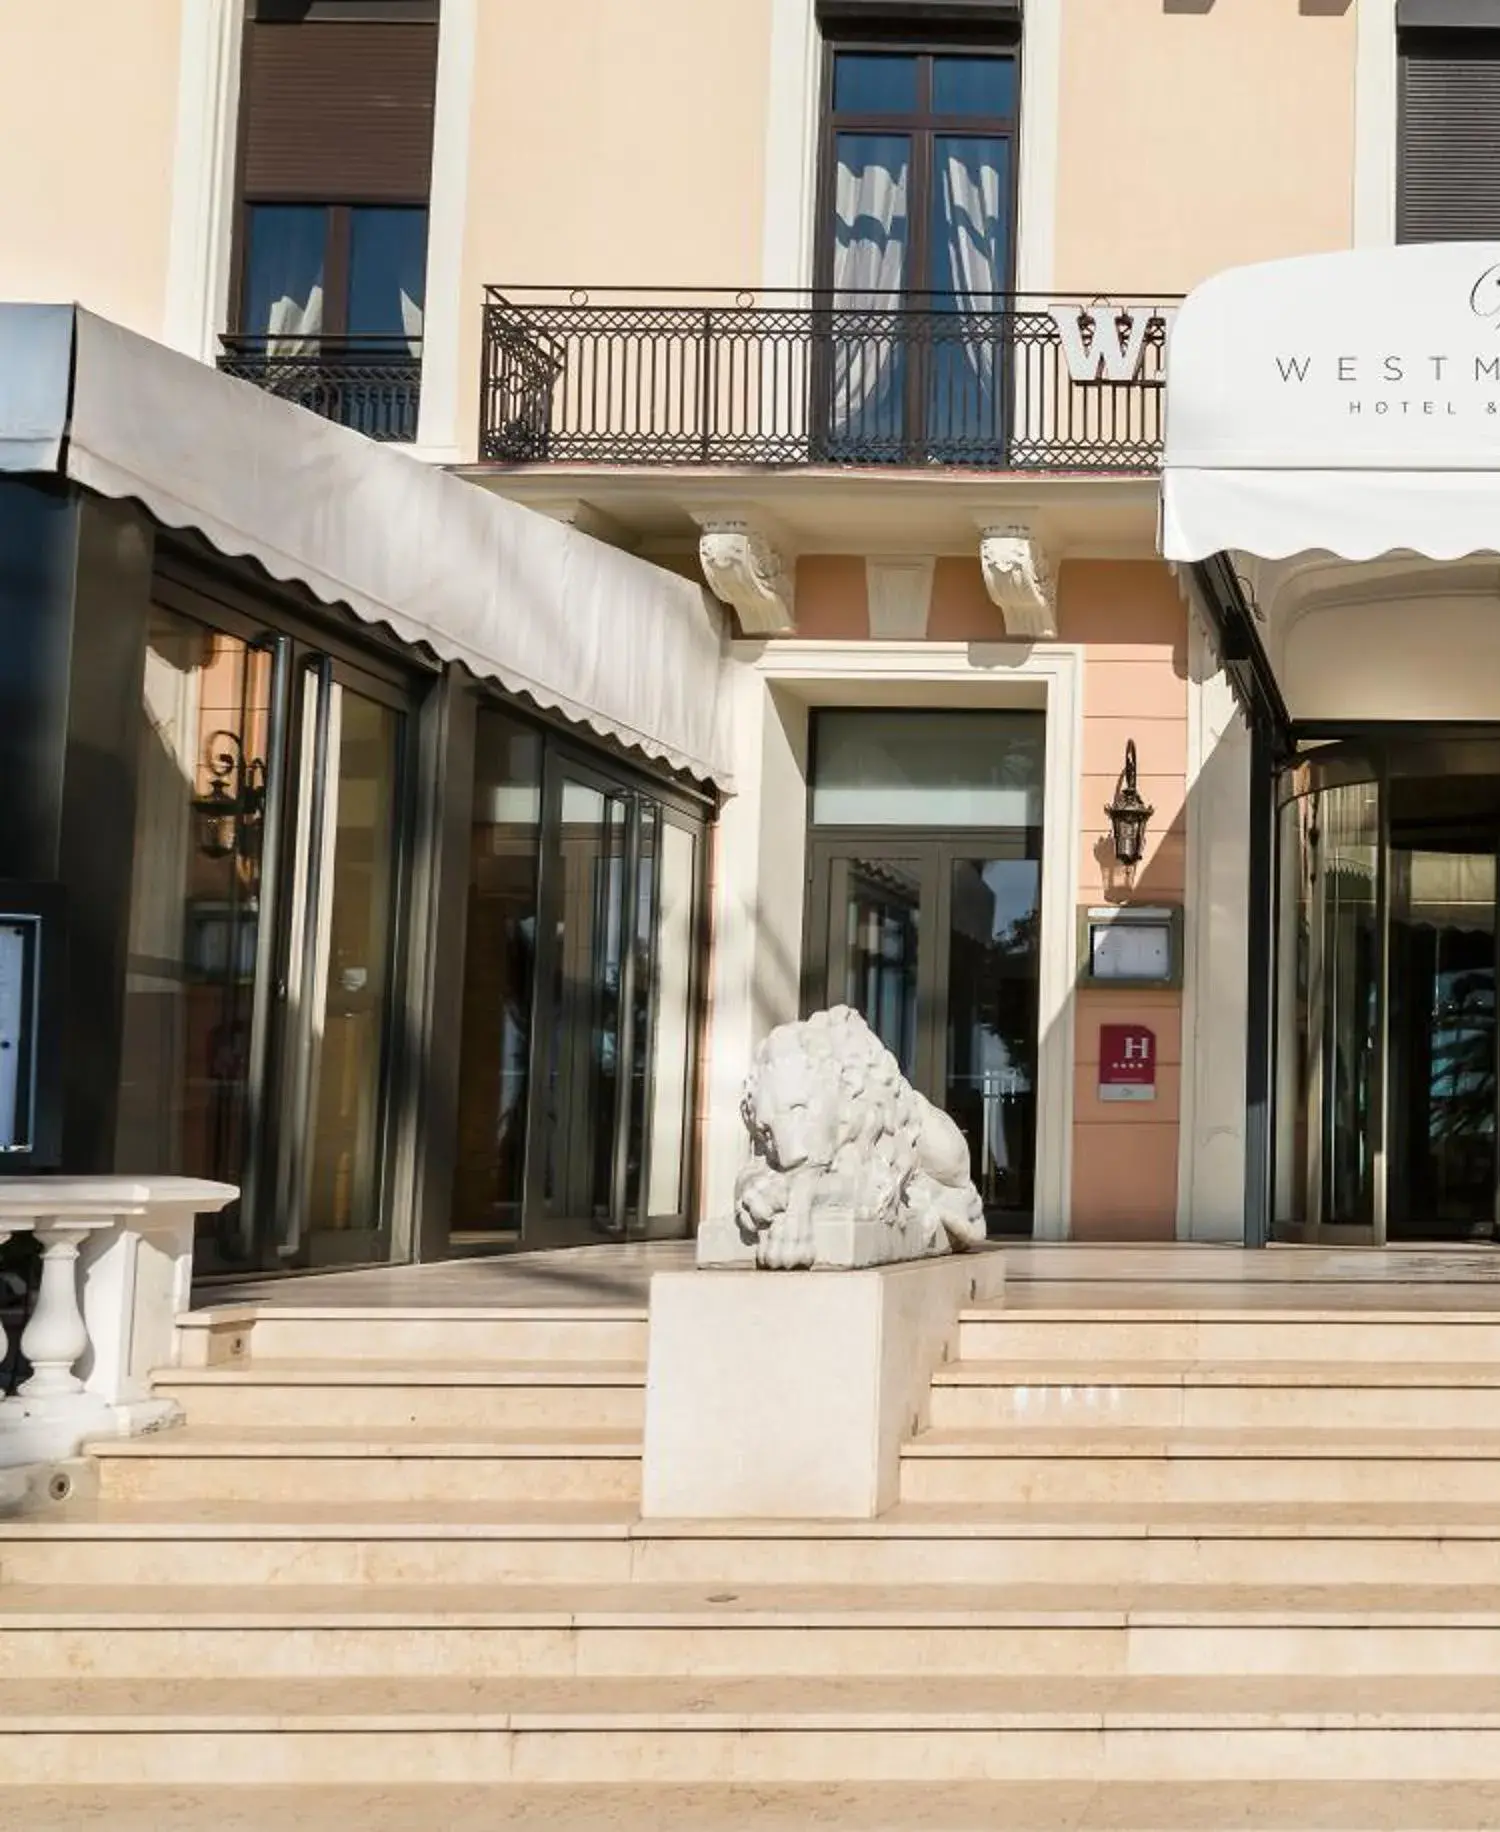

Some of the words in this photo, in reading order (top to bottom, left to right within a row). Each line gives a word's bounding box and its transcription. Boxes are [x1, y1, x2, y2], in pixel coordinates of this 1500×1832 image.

[1348, 400, 1457, 415] HOTEL
[1485, 400, 1498, 415] &
[1124, 1037, 1150, 1059] H
